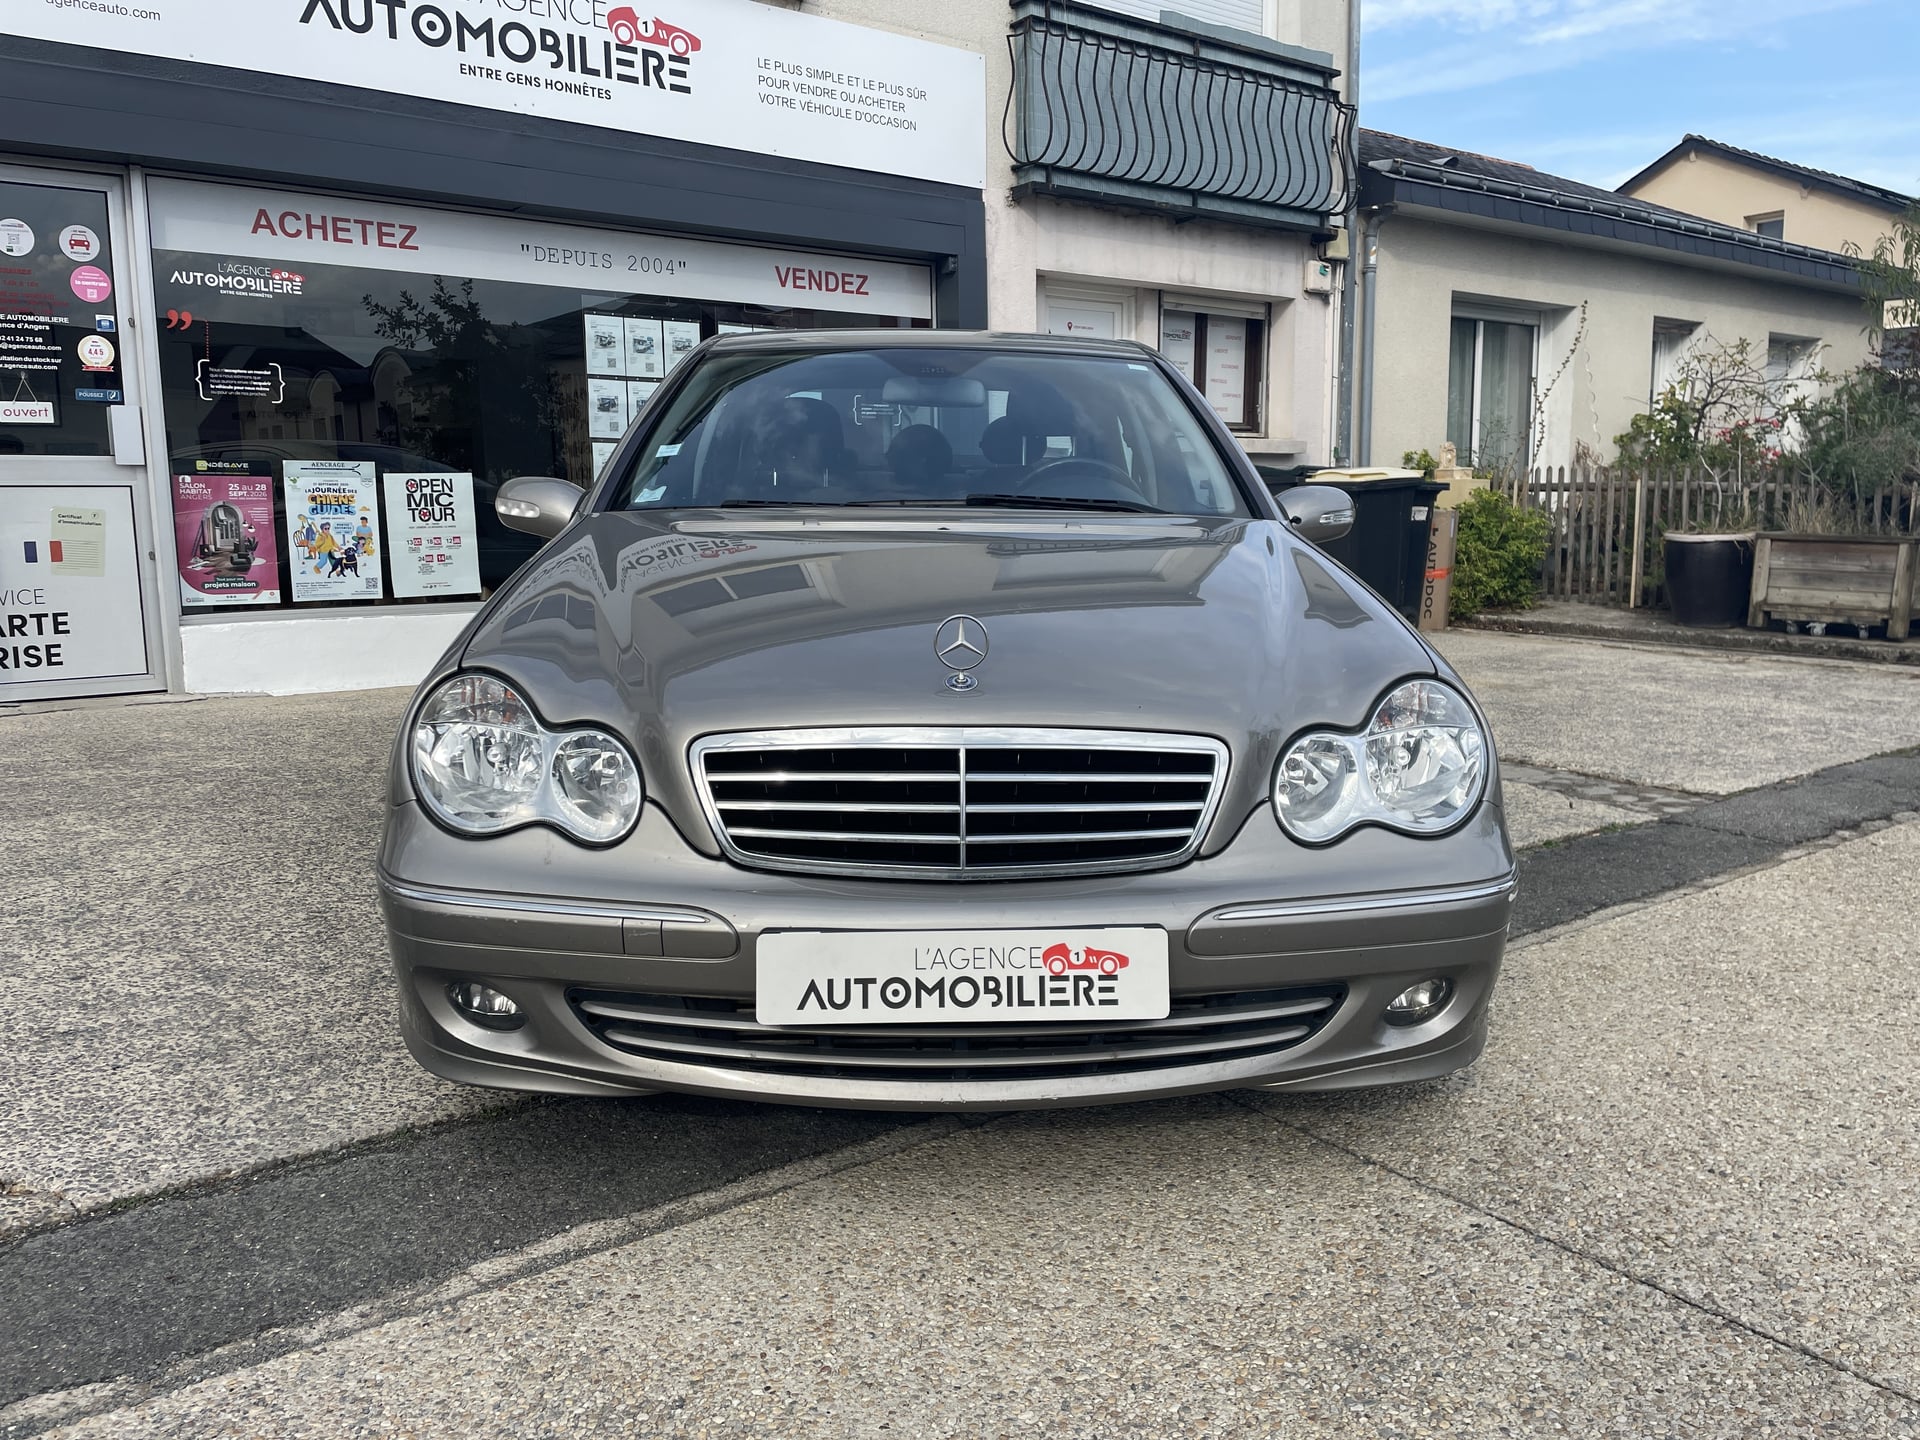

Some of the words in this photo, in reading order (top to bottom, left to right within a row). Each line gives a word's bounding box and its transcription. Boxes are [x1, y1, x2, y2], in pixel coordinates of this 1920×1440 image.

[459, 63, 502, 81] ENTRE
[506, 72, 542, 88] GENS
[545, 78, 612, 100] HONNÊTES
[757, 57, 771, 70] LE
[774, 61, 803, 76] PLUS
[805, 67, 845, 84] SIMPLE
[847, 75, 861, 87] ET
[863, 79, 876, 91] LE
[878, 82, 904, 96] PLUS
[906, 87, 927, 101] SÛR
[758, 75, 790, 91] POUR
[792, 81, 837, 100] VENDRE
[840, 91, 856, 103] OU
[857, 94, 906, 112] ACHETER
[758, 92, 797, 109] VOTRE
[799, 99, 852, 119] VÉHICULE
[855, 110, 917, 131] D'OCCASION
[251, 208, 419, 251] ACHETEZ
[520, 243, 613, 270] "DEPUIS
[627, 255, 687, 275] 2004"
[217, 263, 271, 278] L'AGENCE
[774, 265, 870, 296] VENDEZ
[6, 314, 70, 324] AUTOMOBILIERE
[17, 322, 50, 331] d'Angers
[3, 406, 48, 417] ouvert
[228, 483, 240, 491] 25
[255, 483, 267, 491] 28
[312, 486, 347, 494] JOURNÉE
[406, 478, 454, 493] OPEN
[308, 494, 356, 505] CHIENS
[406, 493, 454, 507] MIC
[308, 504, 357, 516] GUIDES
[407, 507, 456, 522] TOUR
[915, 946, 1043, 971] L'AGENCE
[1073, 951, 1081, 962] 1
[797, 974, 1119, 1011] AUTOMOBILIERE
